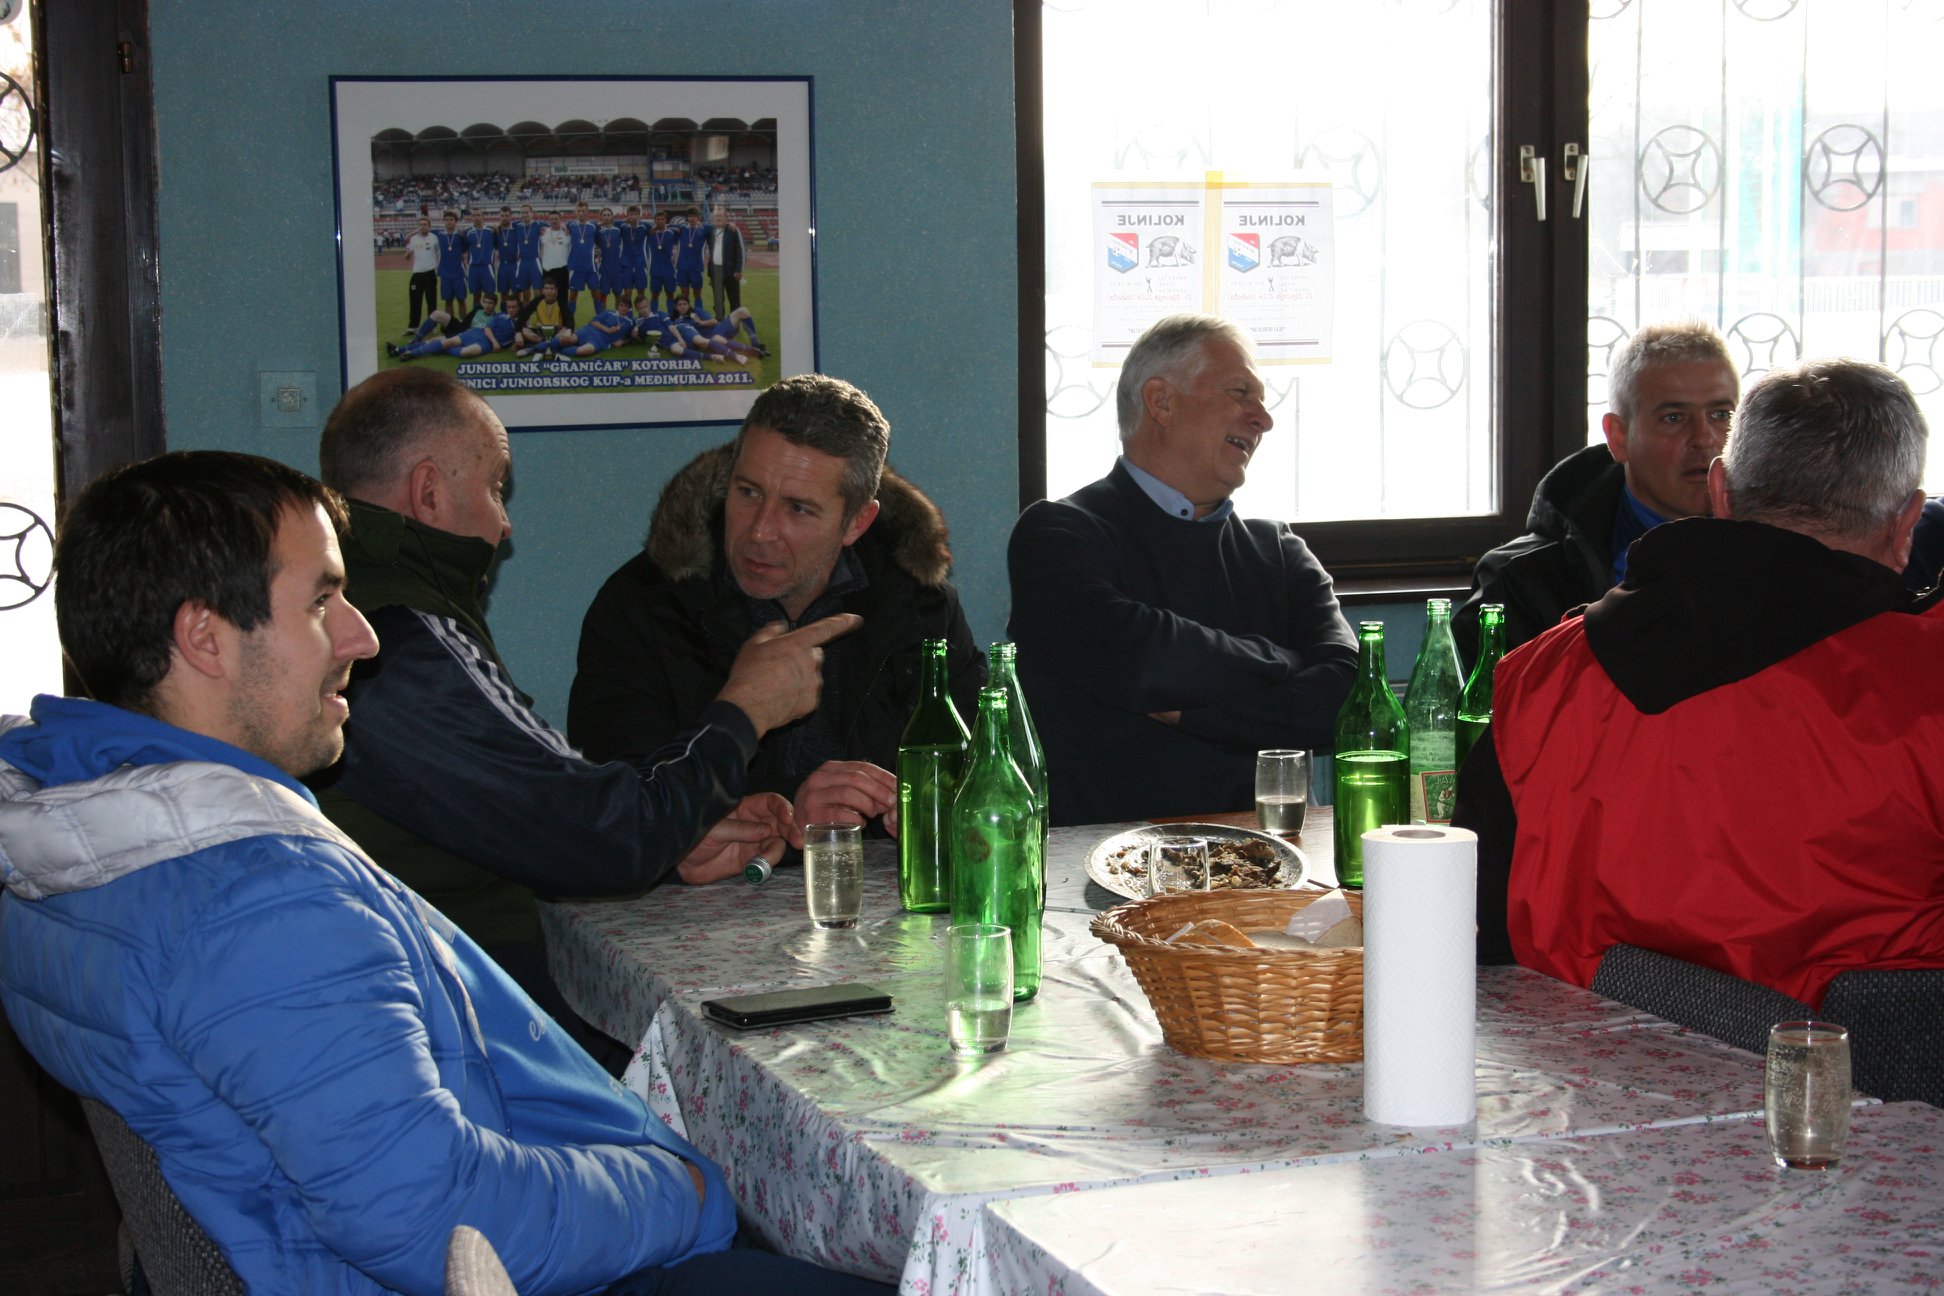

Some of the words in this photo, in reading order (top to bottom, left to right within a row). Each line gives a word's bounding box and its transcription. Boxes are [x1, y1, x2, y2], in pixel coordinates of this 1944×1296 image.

[457, 363, 516, 374] JUNIORI
[519, 363, 540, 373] NK
[630, 359, 702, 371] KOTORIBA
[500, 377, 590, 388] JUNIORSKOG
[592, 375, 631, 386] KUP-a
[634, 374, 714, 385] MEĐIMURJA
[717, 373, 753, 384] 2011.
